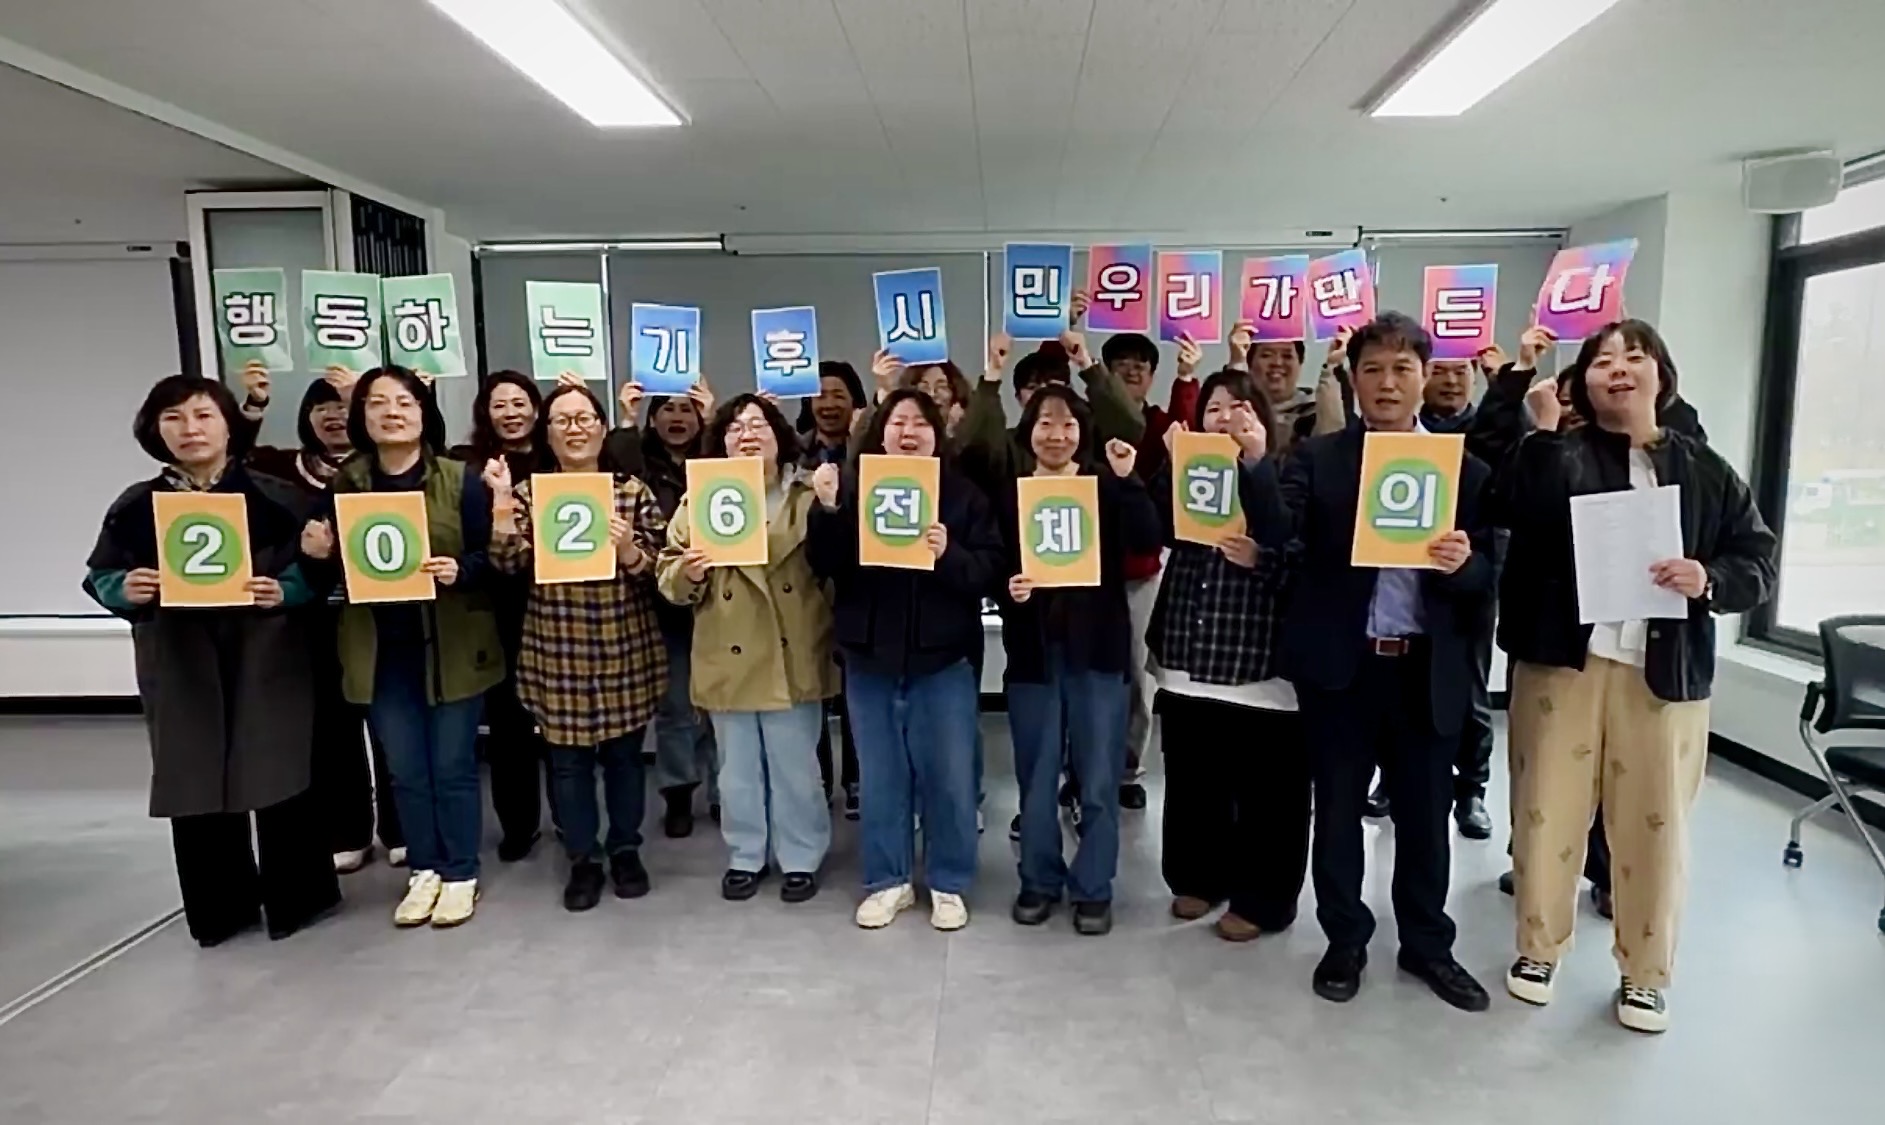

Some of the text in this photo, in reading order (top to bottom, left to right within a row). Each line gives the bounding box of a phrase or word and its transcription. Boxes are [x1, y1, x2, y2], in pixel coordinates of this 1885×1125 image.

[1013, 264, 1062, 315] 민
[1096, 264, 1142, 310] 우
[1166, 272, 1212, 319] 리
[1252, 276, 1298, 318] 가
[1312, 268, 1363, 316] 만
[1549, 264, 1613, 314] 다
[223, 292, 277, 347] 행
[314, 295, 370, 349] 동
[393, 299, 448, 351] 하
[540, 308, 593, 356] 는
[888, 292, 936, 342] 시
[1433, 288, 1484, 338] 든
[641, 326, 689, 374] 기
[763, 329, 812, 376] 후
[706, 486, 747, 536] 6
[873, 485, 923, 538] 전
[1186, 464, 1235, 517] 회
[1375, 471, 1437, 530] 의
[182, 522, 228, 575] 2
[363, 521, 407, 572] 0
[555, 501, 596, 552] 2
[1033, 504, 1082, 555] 체
